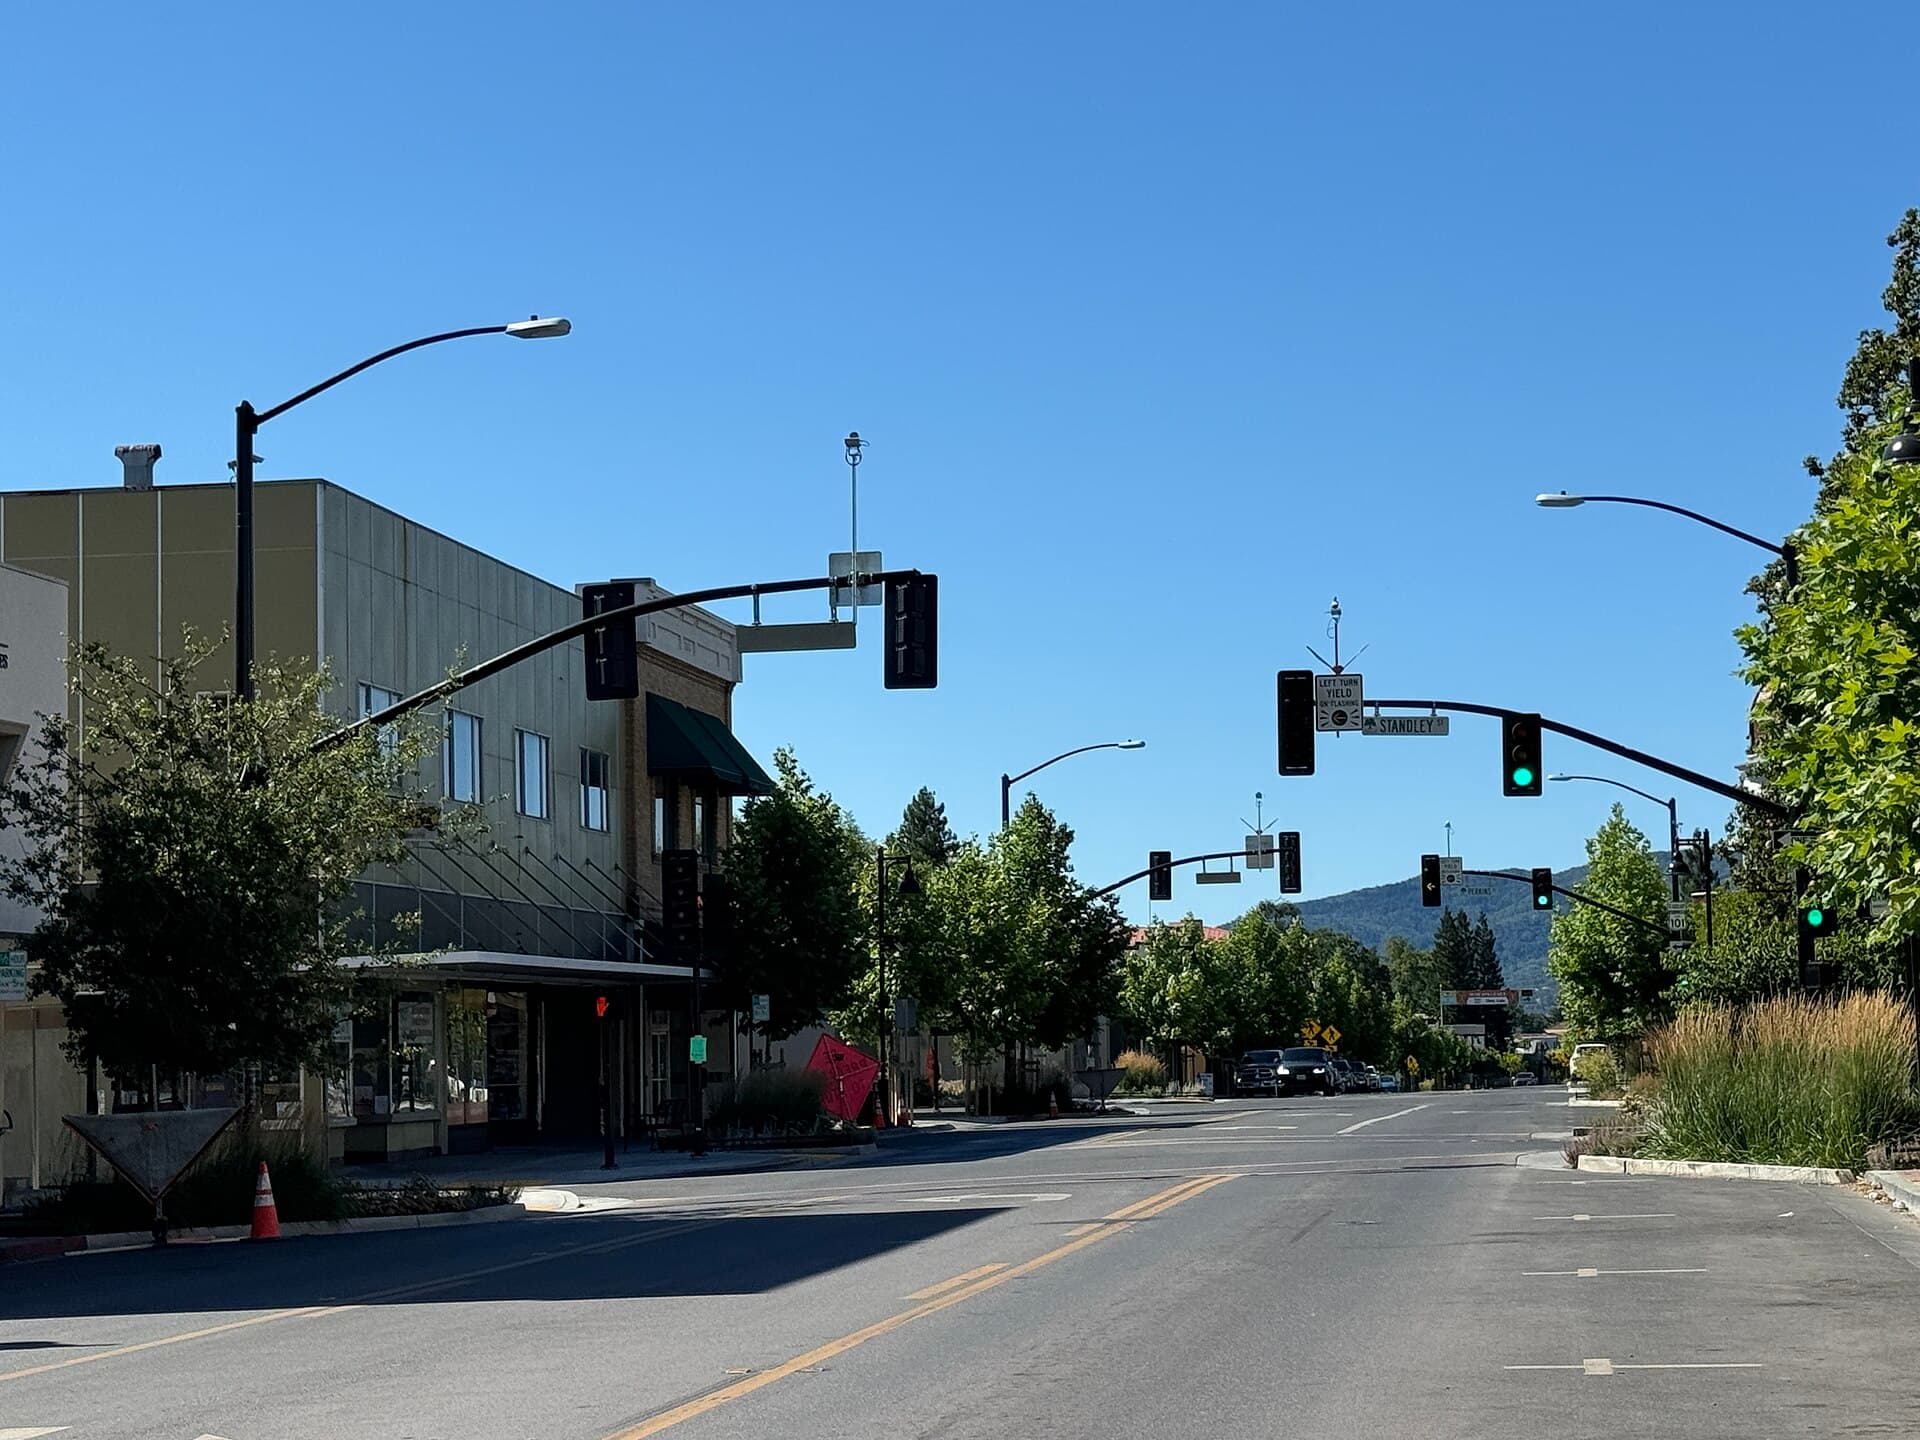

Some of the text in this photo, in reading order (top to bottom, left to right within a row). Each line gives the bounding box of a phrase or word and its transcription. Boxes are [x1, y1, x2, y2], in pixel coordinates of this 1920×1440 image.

[1320, 679, 1359, 687] LEFT TURN
[1326, 688, 1352, 698] YIELD
[1380, 719, 1434, 733] STANDLEY
[1671, 918, 1685, 928] 101
